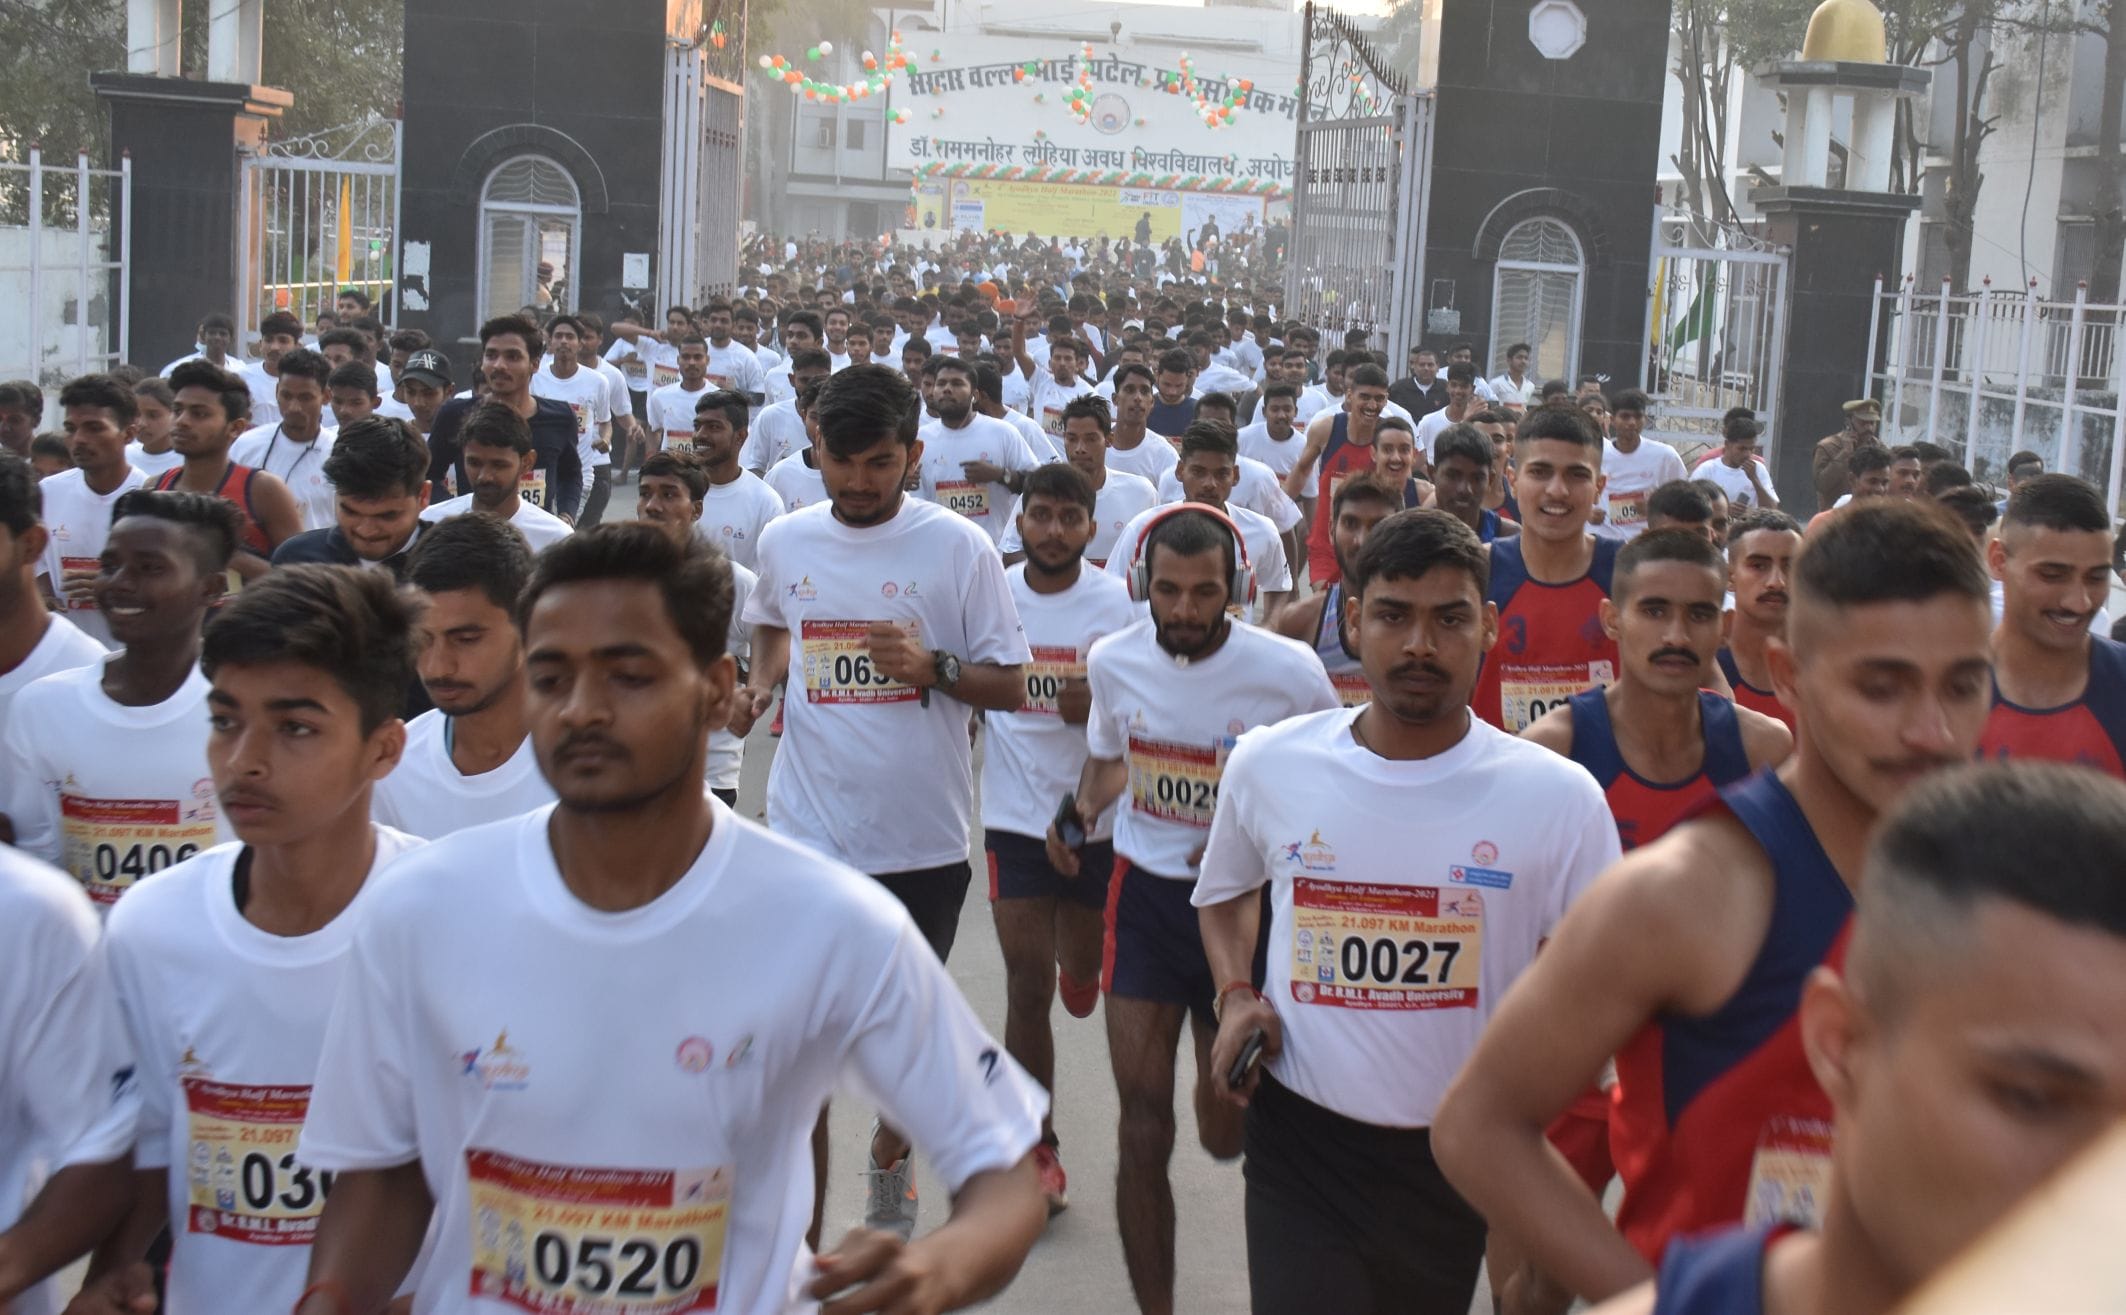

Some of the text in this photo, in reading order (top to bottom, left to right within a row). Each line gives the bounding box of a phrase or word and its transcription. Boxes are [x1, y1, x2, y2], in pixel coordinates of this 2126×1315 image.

[1086, 52, 1147, 86] पटेल
[909, 135, 932, 158] डॉ.
[935, 136, 1017, 163] राममनोहर
[1022, 139, 1081, 168] लोहिया
[1081, 149, 1126, 170] अवध
[950, 495, 984, 510] 0452
[1506, 615, 1527, 656] 3
[834, 655, 903, 686] 06
[876, 687, 917, 698] University
[1528, 684, 1555, 695] 21.097
[1558, 685, 1573, 695] KM
[158, 826, 215, 838] Marathon
[1344, 884, 1366, 896] Half
[1340, 915, 1385, 930] 21.097
[1388, 917, 1410, 932] KM
[1413, 920, 1477, 934] Marathon
[1341, 935, 1462, 985] 0027
[1319, 984, 1465, 1002] Dr. R.M.L. Avadh University
[240, 1088, 268, 1101] Half
[240, 1127, 294, 1144] 21.097
[636, 1205, 724, 1231] Marathon
[534, 1232, 700, 1297] 0520
